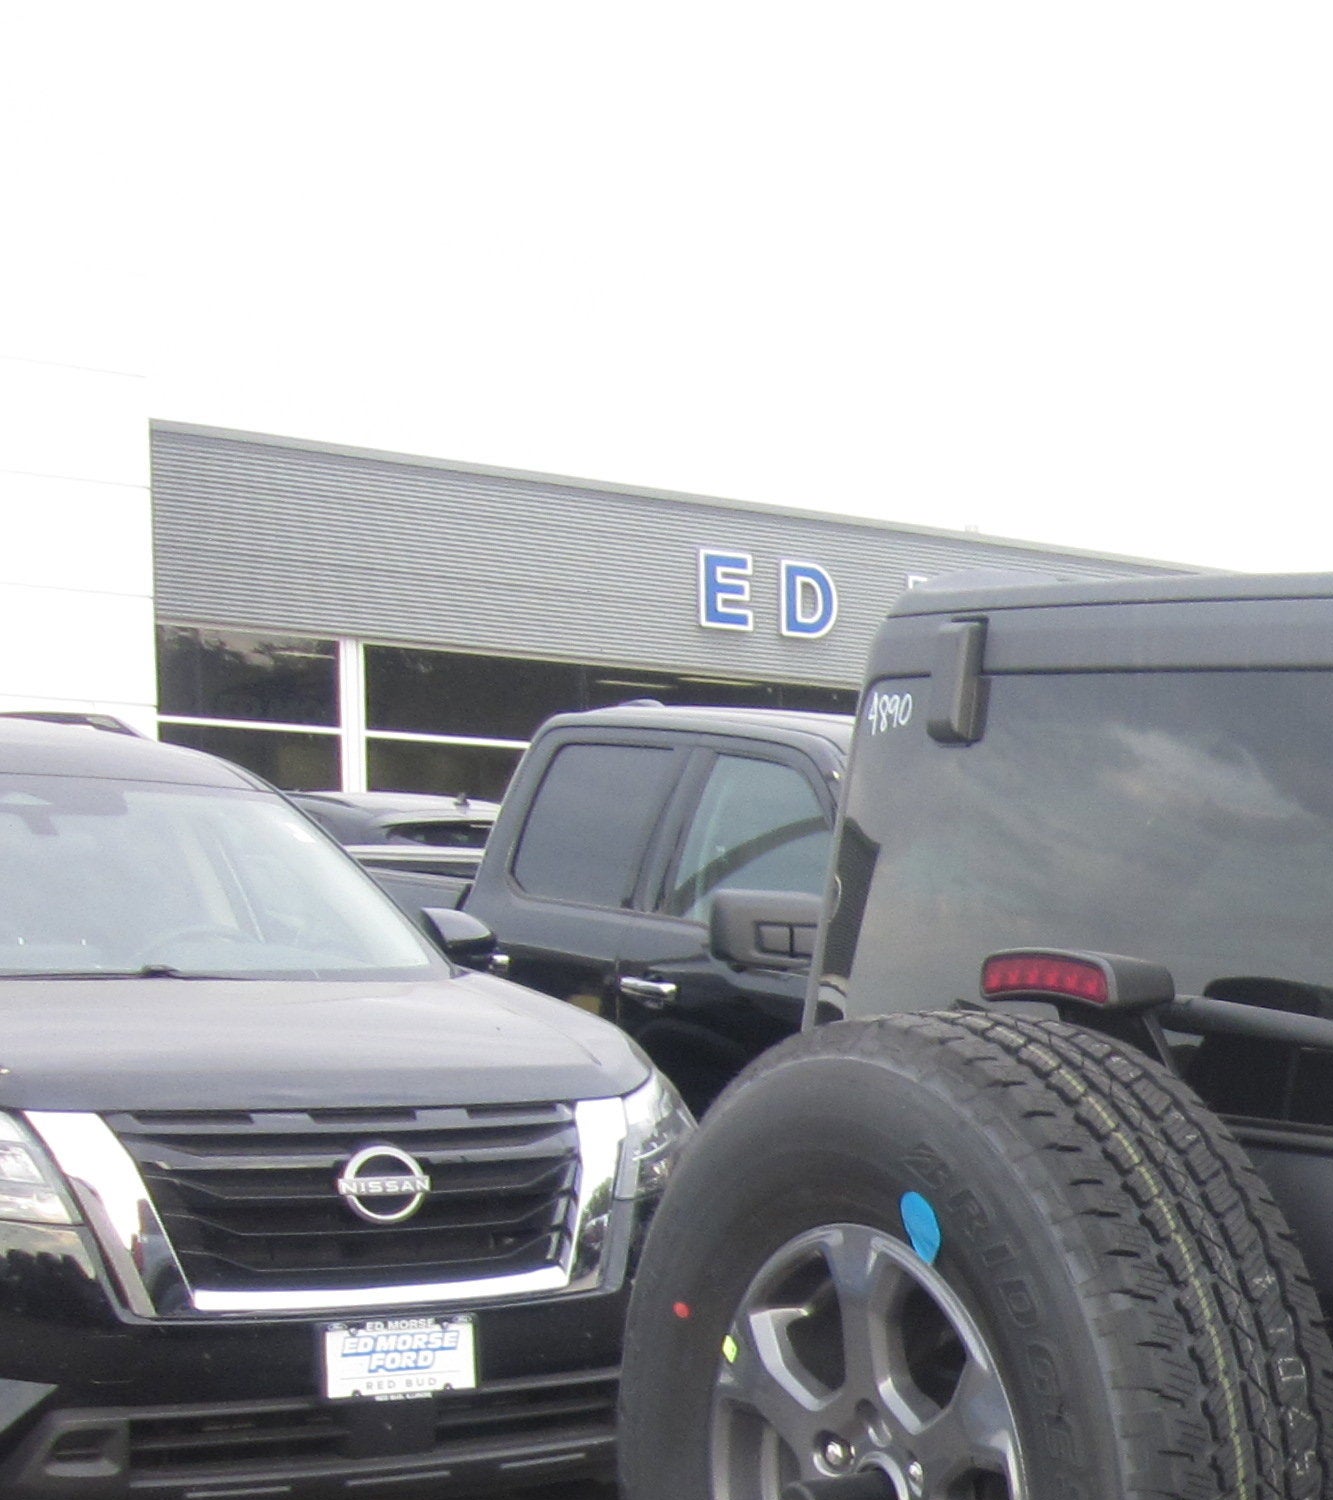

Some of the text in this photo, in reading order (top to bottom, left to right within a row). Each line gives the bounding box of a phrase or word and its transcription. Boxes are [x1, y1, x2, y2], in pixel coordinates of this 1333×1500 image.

[696, 549, 838, 638] ED
[867, 692, 912, 735] 4890
[340, 1178, 430, 1194] NISSAN
[366, 1318, 435, 1332] ED MORSE
[342, 1330, 459, 1356] ED MORSE
[368, 1350, 435, 1373] FORD
[366, 1377, 438, 1391] RED BUD
